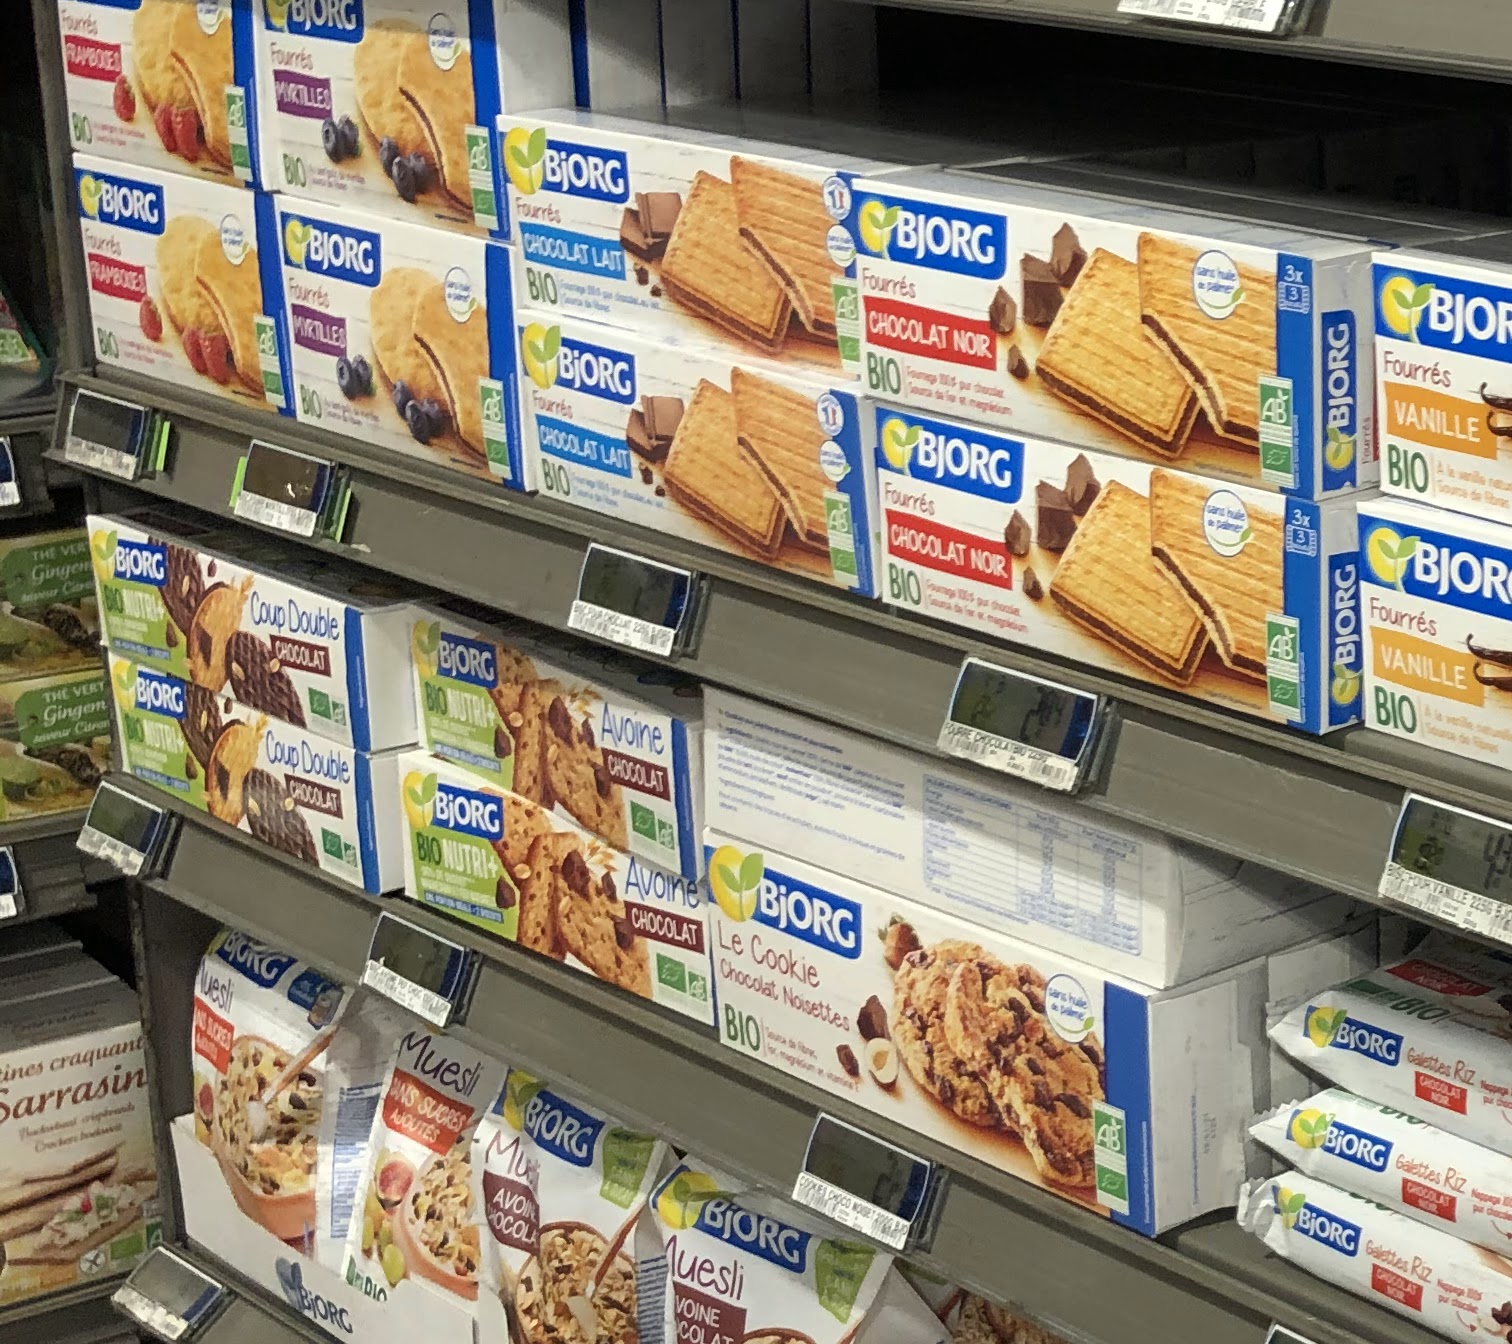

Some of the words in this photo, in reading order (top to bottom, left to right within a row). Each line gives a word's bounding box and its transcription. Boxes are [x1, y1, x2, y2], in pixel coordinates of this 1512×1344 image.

[271, 43, 314, 71] Fourrés
[515, 196, 562, 224] Fourrés
[309, 232, 375, 276] BJORG
[525, 230, 588, 266] CHOCOLAT
[591, 246, 622, 272] LAIT
[896, 221, 996, 265] BJORG
[527, 267, 558, 305] BIO
[862, 266, 916, 298] Fourrés
[870, 314, 949, 350] CHOCOLAT
[953, 331, 991, 358] NOIR
[867, 352, 901, 395] BIO
[1327, 322, 1351, 429] BJORG
[1384, 351, 1452, 389] Fourrés
[1394, 399, 1482, 444] VANILLE
[917, 435, 1012, 488] BJORG
[1387, 444, 1430, 494] BIO
[890, 525, 968, 565] CHOCOLAT
[970, 551, 1008, 578] NOIR
[251, 591, 286, 630] Coup
[287, 601, 341, 642] Double
[275, 639, 327, 672] CHOCOLAT
[1382, 644, 1468, 690] VANILLE
[601, 702, 665, 755] Avoine
[444, 843, 499, 882] NUTRI+
[625, 858, 701, 910] Avoine
[631, 909, 698, 946] CHOCOLAT
[717, 919, 743, 953] Le
[750, 934, 822, 989] Cookie
[720, 956, 779, 1002] Chocolat
[783, 986, 851, 1033] Noisettes
[724, 1002, 761, 1053] BIO
[1406, 1047, 1453, 1078] Galettes
[1453, 1059, 1476, 1087] Riz
